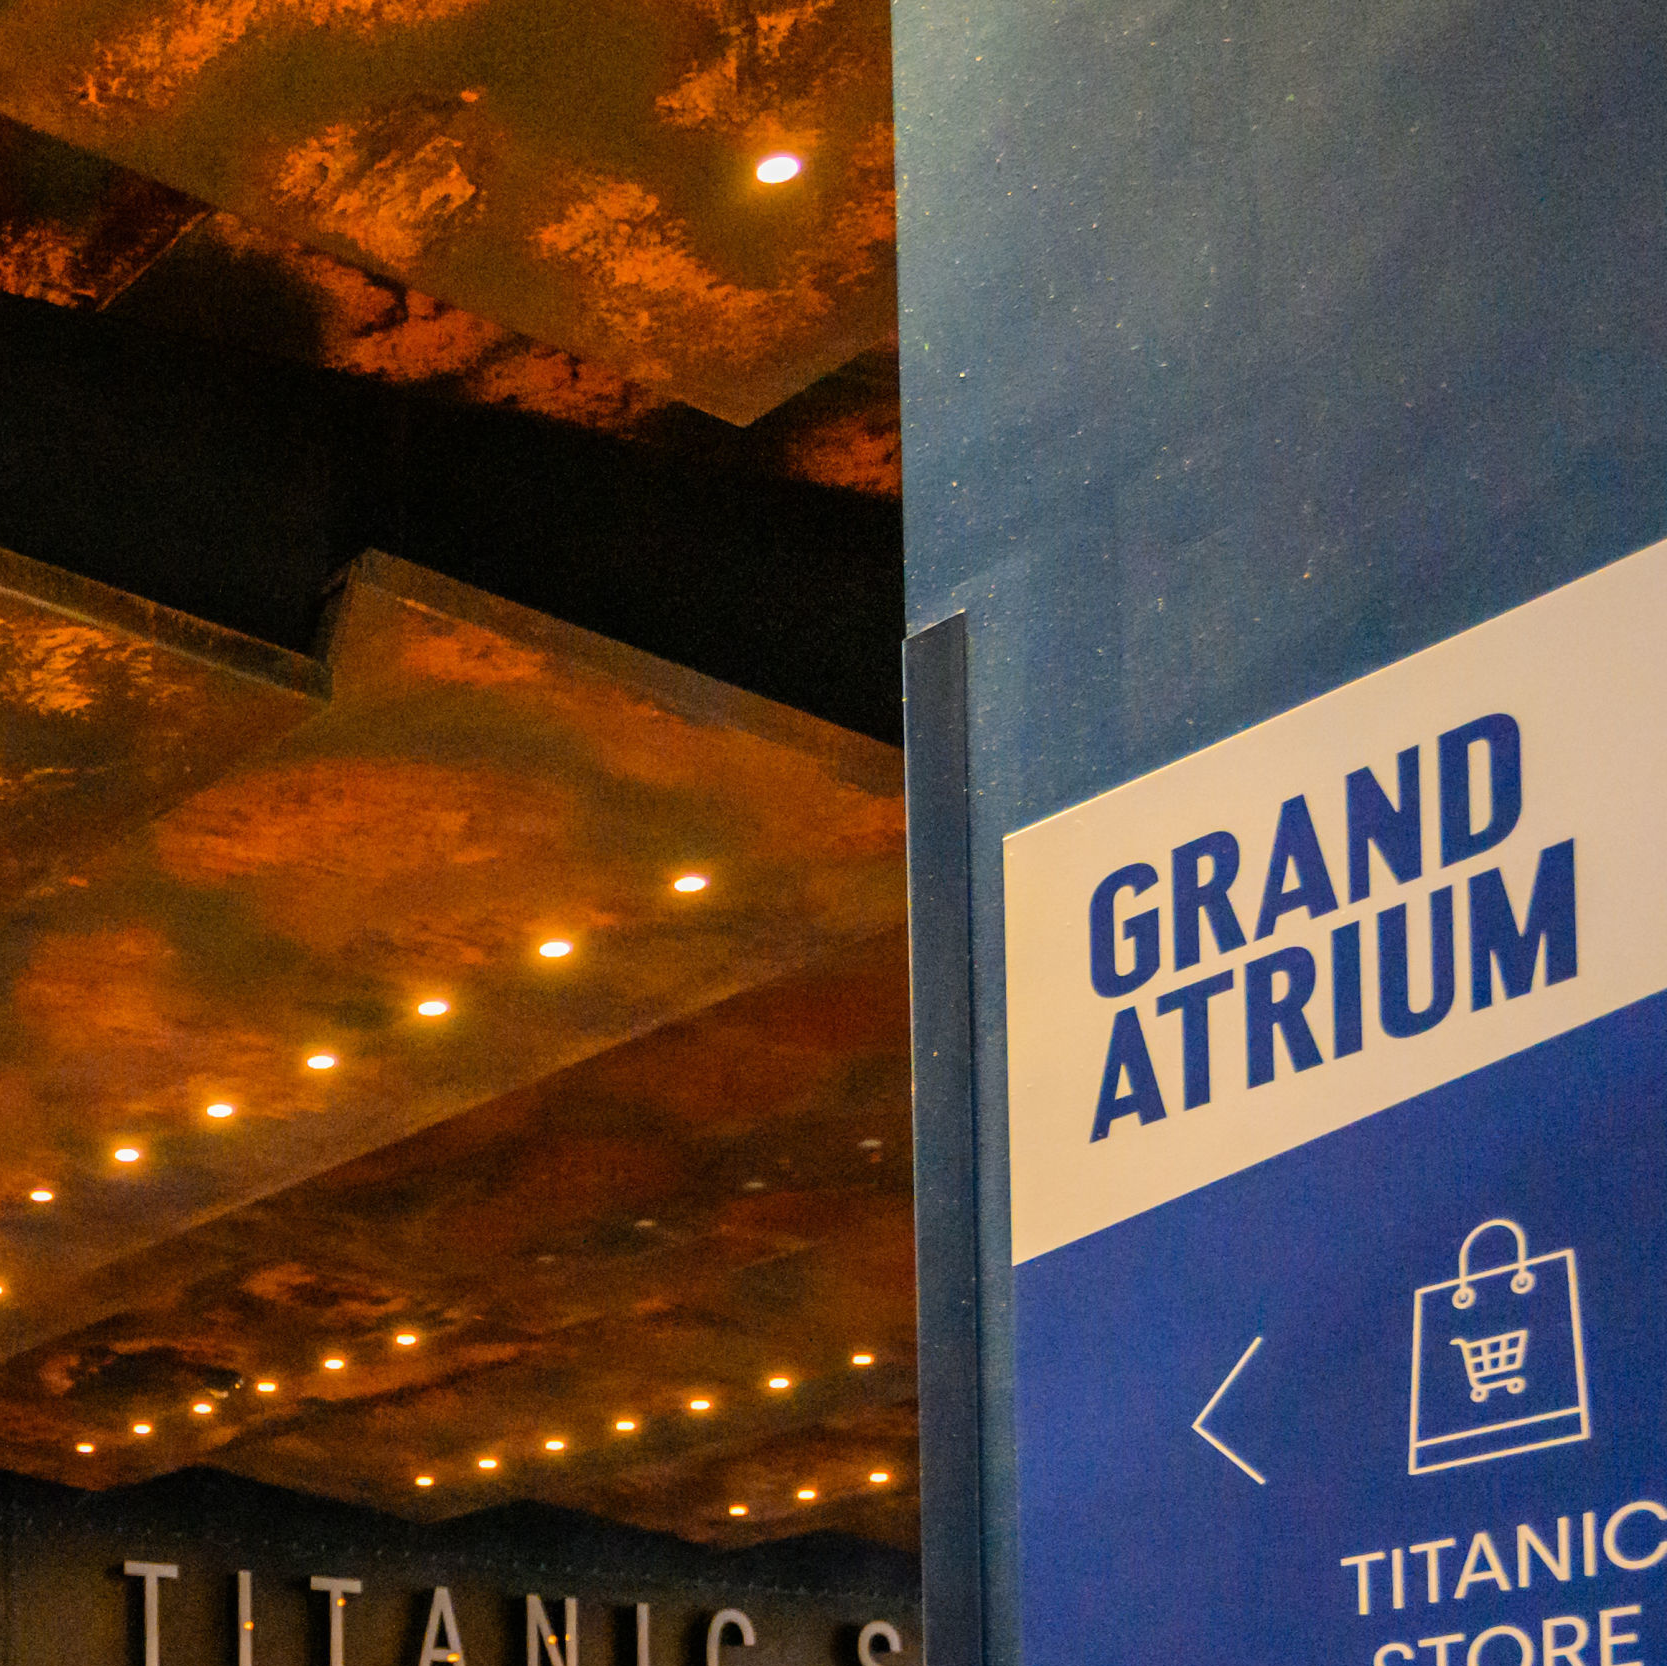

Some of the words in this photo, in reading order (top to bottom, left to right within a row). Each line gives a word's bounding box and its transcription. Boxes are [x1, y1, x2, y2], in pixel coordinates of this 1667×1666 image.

[1088, 712, 1523, 998] GRAND
[1088, 837, 1579, 1144] ATRIUM
[1340, 1500, 1667, 1616] TITANIC
